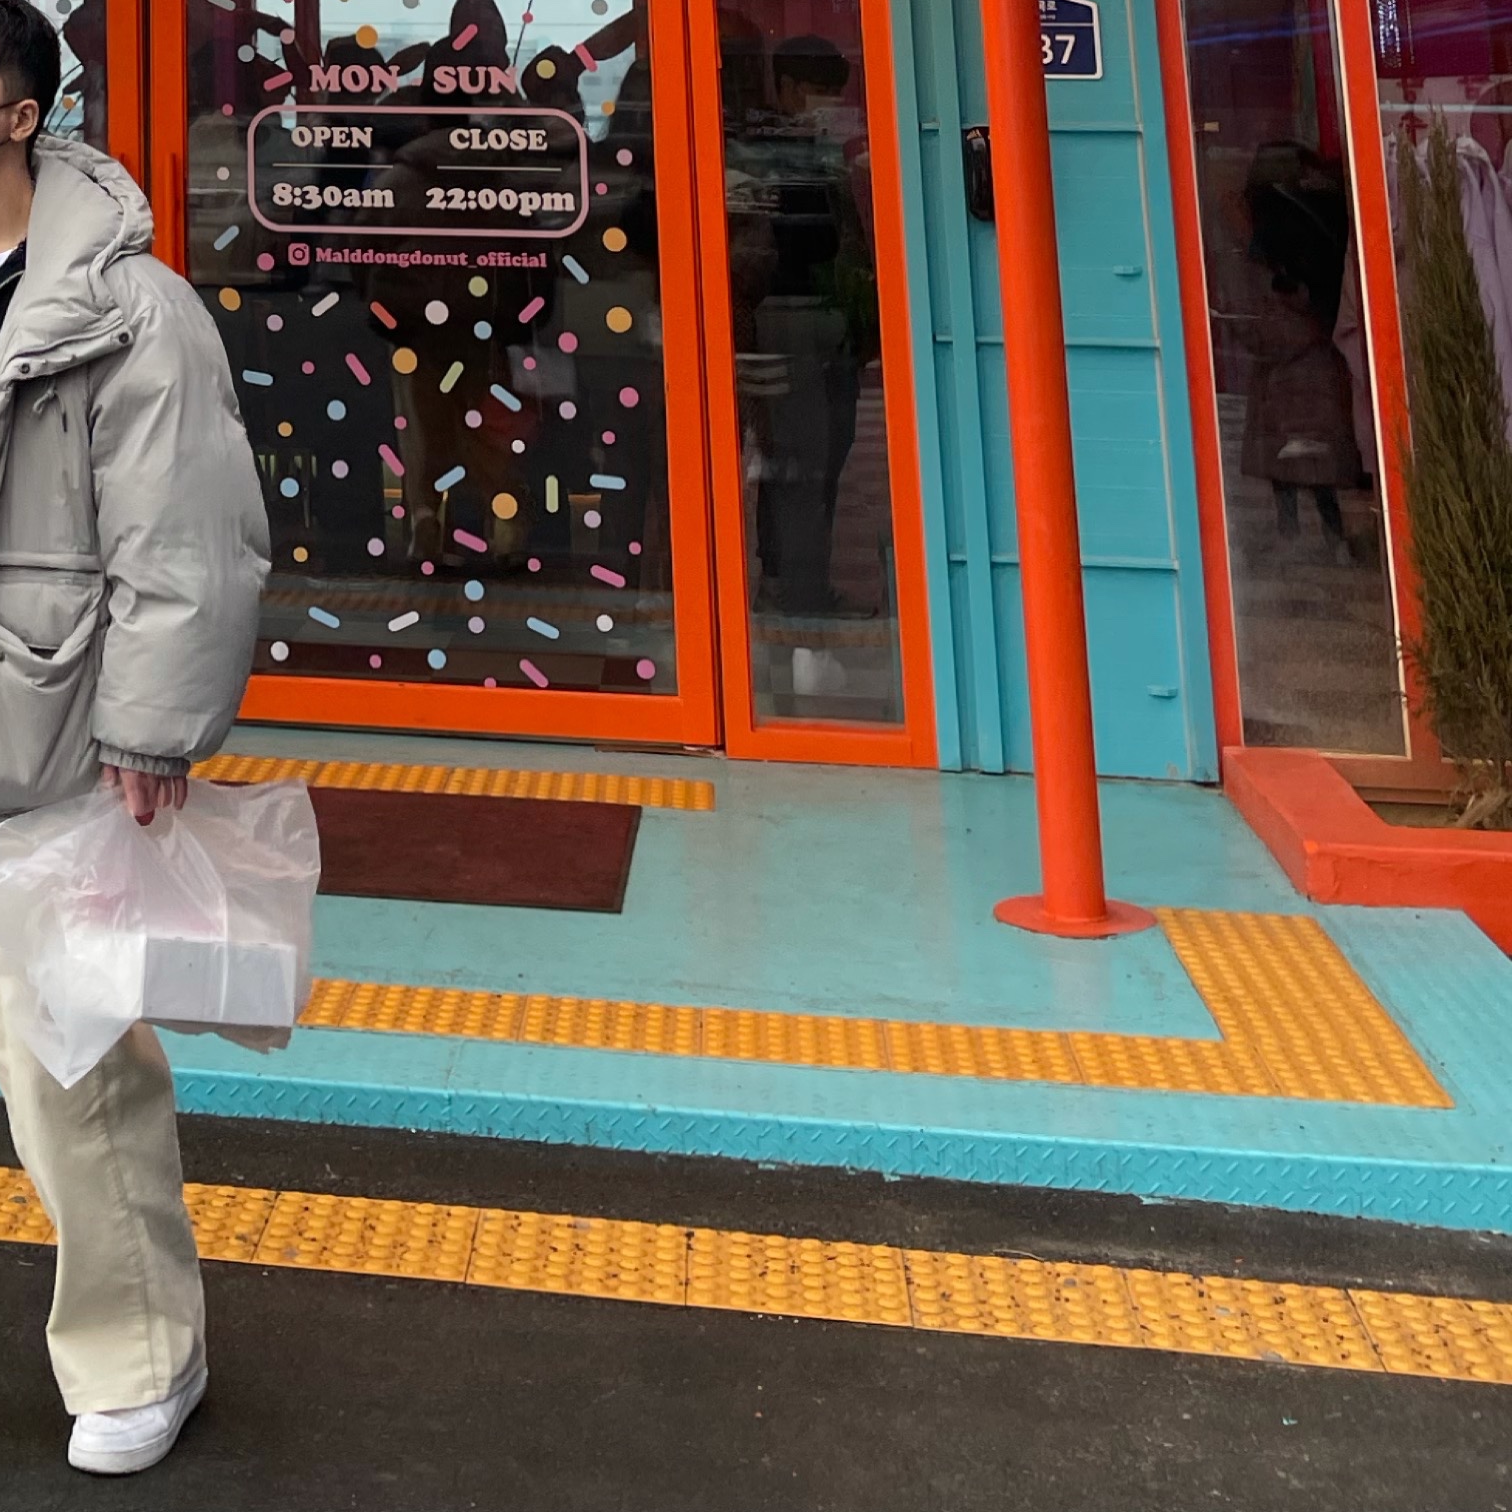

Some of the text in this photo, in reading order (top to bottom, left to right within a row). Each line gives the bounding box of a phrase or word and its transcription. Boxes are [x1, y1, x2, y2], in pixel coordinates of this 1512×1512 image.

[309, 65, 400, 93] MON
[433, 66, 517, 94] SUN
[291, 126, 373, 148] OPEN
[449, 128, 548, 151] CLOSE
[272, 183, 394, 209] 8:30am
[425, 188, 576, 216] 22:00pm
[315, 247, 547, 268] Malddongdonut_official
